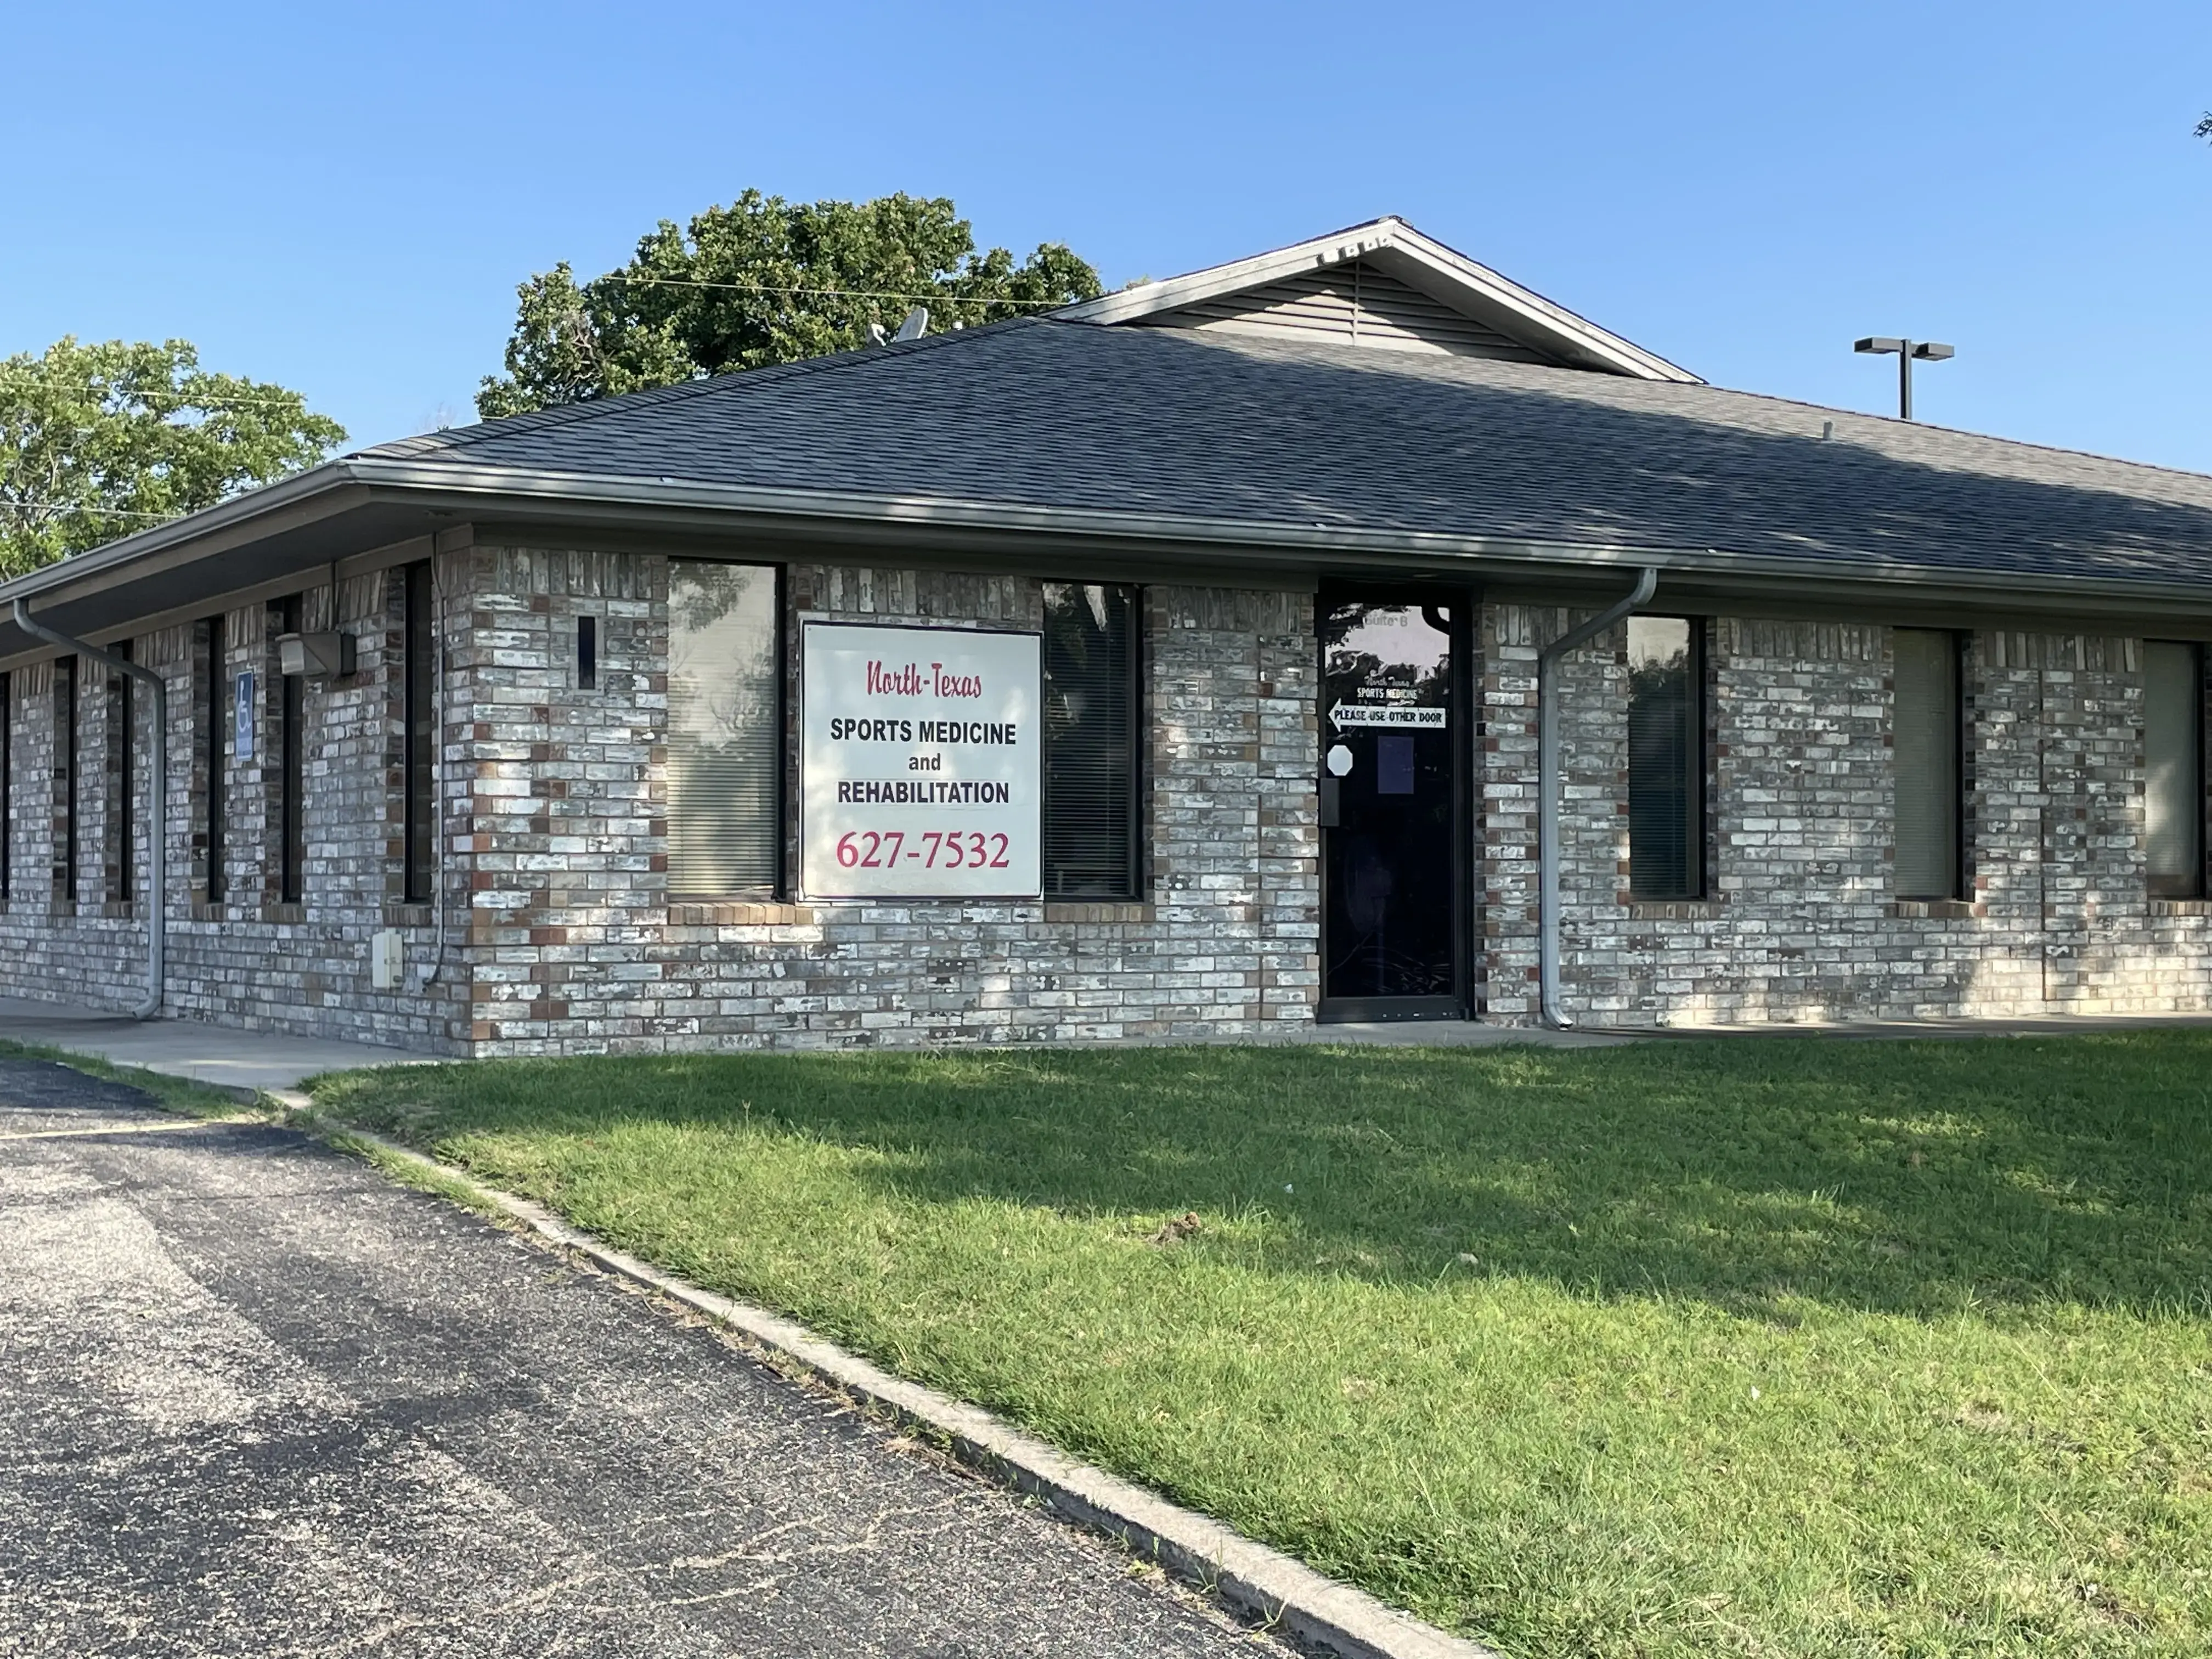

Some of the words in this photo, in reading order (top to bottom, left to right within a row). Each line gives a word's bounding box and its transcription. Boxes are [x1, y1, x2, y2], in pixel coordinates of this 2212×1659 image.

[1400, 616, 1408, 627] B
[867, 660, 981, 698] North-Texas
[1357, 687, 1385, 698] SPORTS
[1334, 709, 1367, 721] PLEASE
[1370, 710, 1386, 721] USE
[1389, 711, 1416, 722] OTHER
[1419, 712, 1442, 723] DOOR
[831, 718, 912, 742] SPORTS
[919, 720, 1017, 744] MEDICINE
[909, 753, 941, 771] and
[838, 781, 1009, 803] REHABILITATION
[836, 831, 1010, 869] 627-7532
